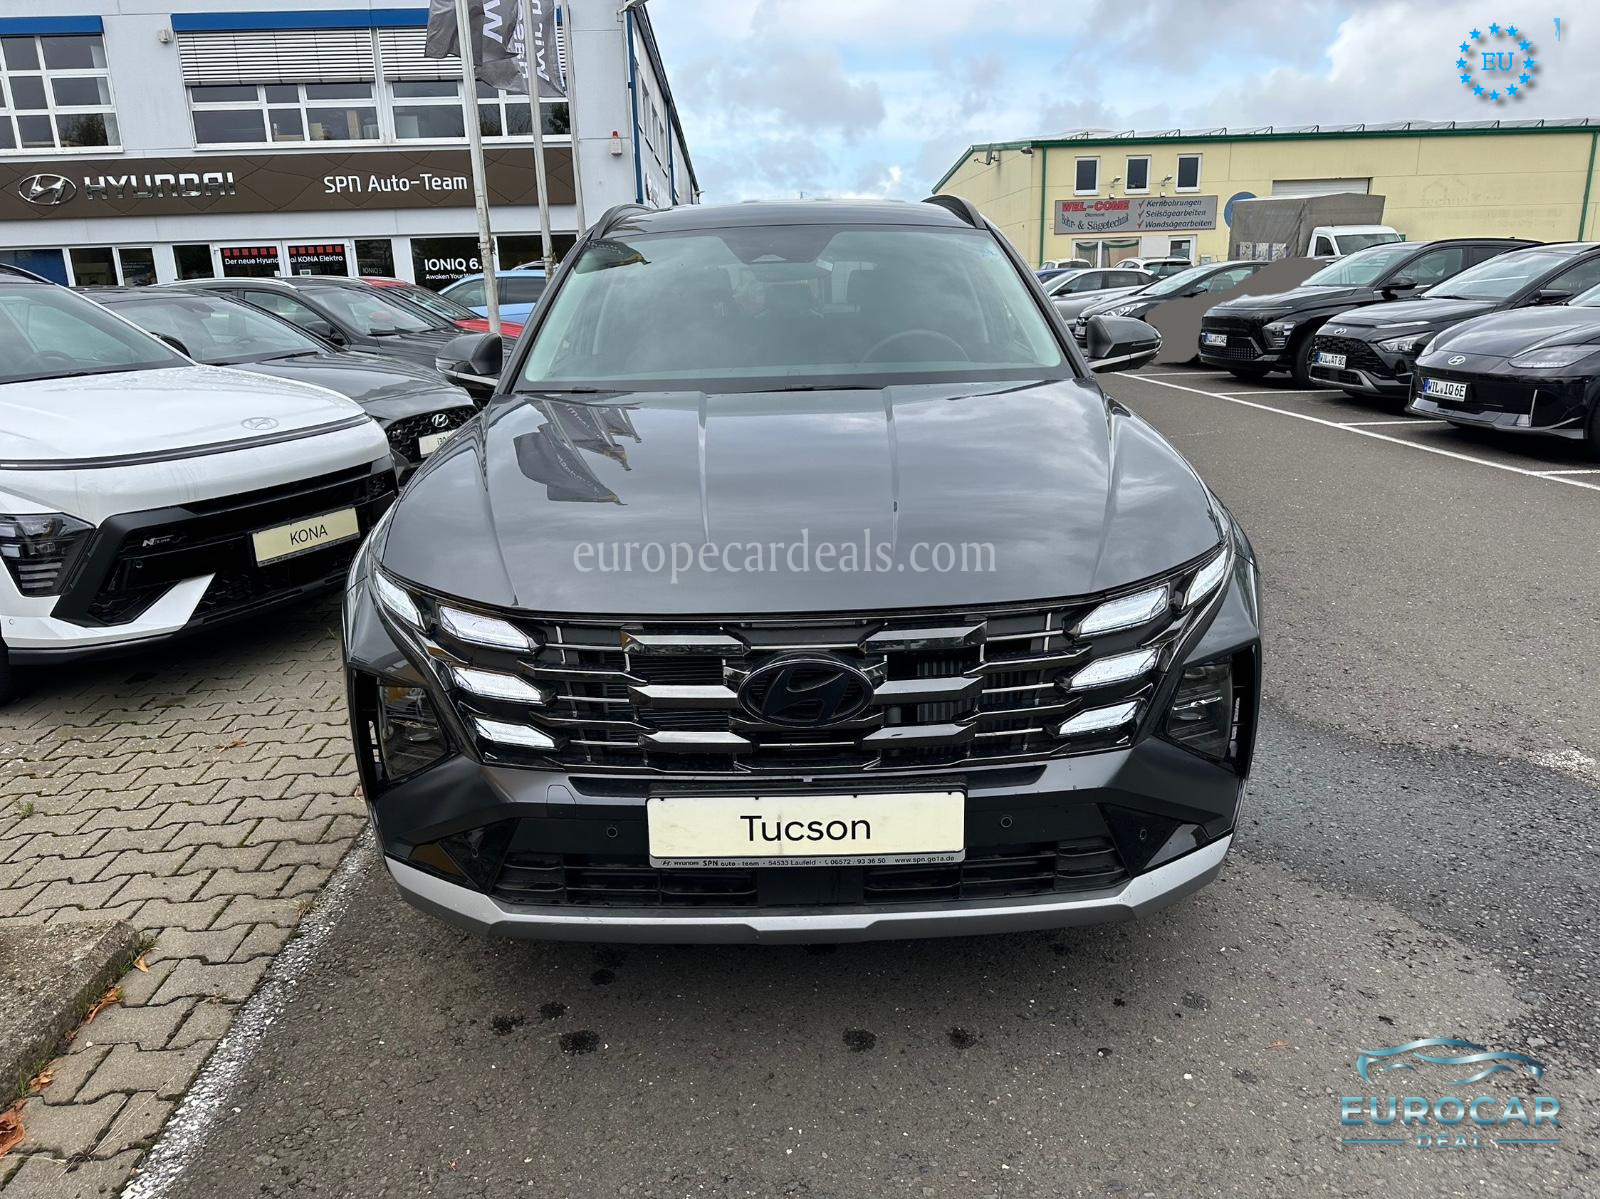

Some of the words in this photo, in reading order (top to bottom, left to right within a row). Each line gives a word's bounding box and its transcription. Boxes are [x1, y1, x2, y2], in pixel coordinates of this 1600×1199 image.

[84, 171, 236, 200] HYUNDAI
[323, 175, 362, 194] SPN
[367, 173, 468, 193] Auto-Team
[1061, 200, 1130, 212] WEL-COME
[1146, 199, 1203, 208] Kernbohrungen
[1145, 209, 1207, 219] Seilsägearbeiten
[1145, 219, 1213, 229] Wandsägearbeiten
[239, 257, 256, 265] neue
[297, 255, 319, 263] KONA
[319, 254, 343, 263] Elektro
[425, 258, 467, 272] IONIQ
[1454, 384, 1466, 398] 6E
[290, 524, 329, 546] KONA
[739, 814, 871, 843] Tucson
[702, 859, 719, 867] SPN
[830, 858, 850, 866] 06572
[857, 857, 866, 865] 93
[867, 857, 876, 865] 36
